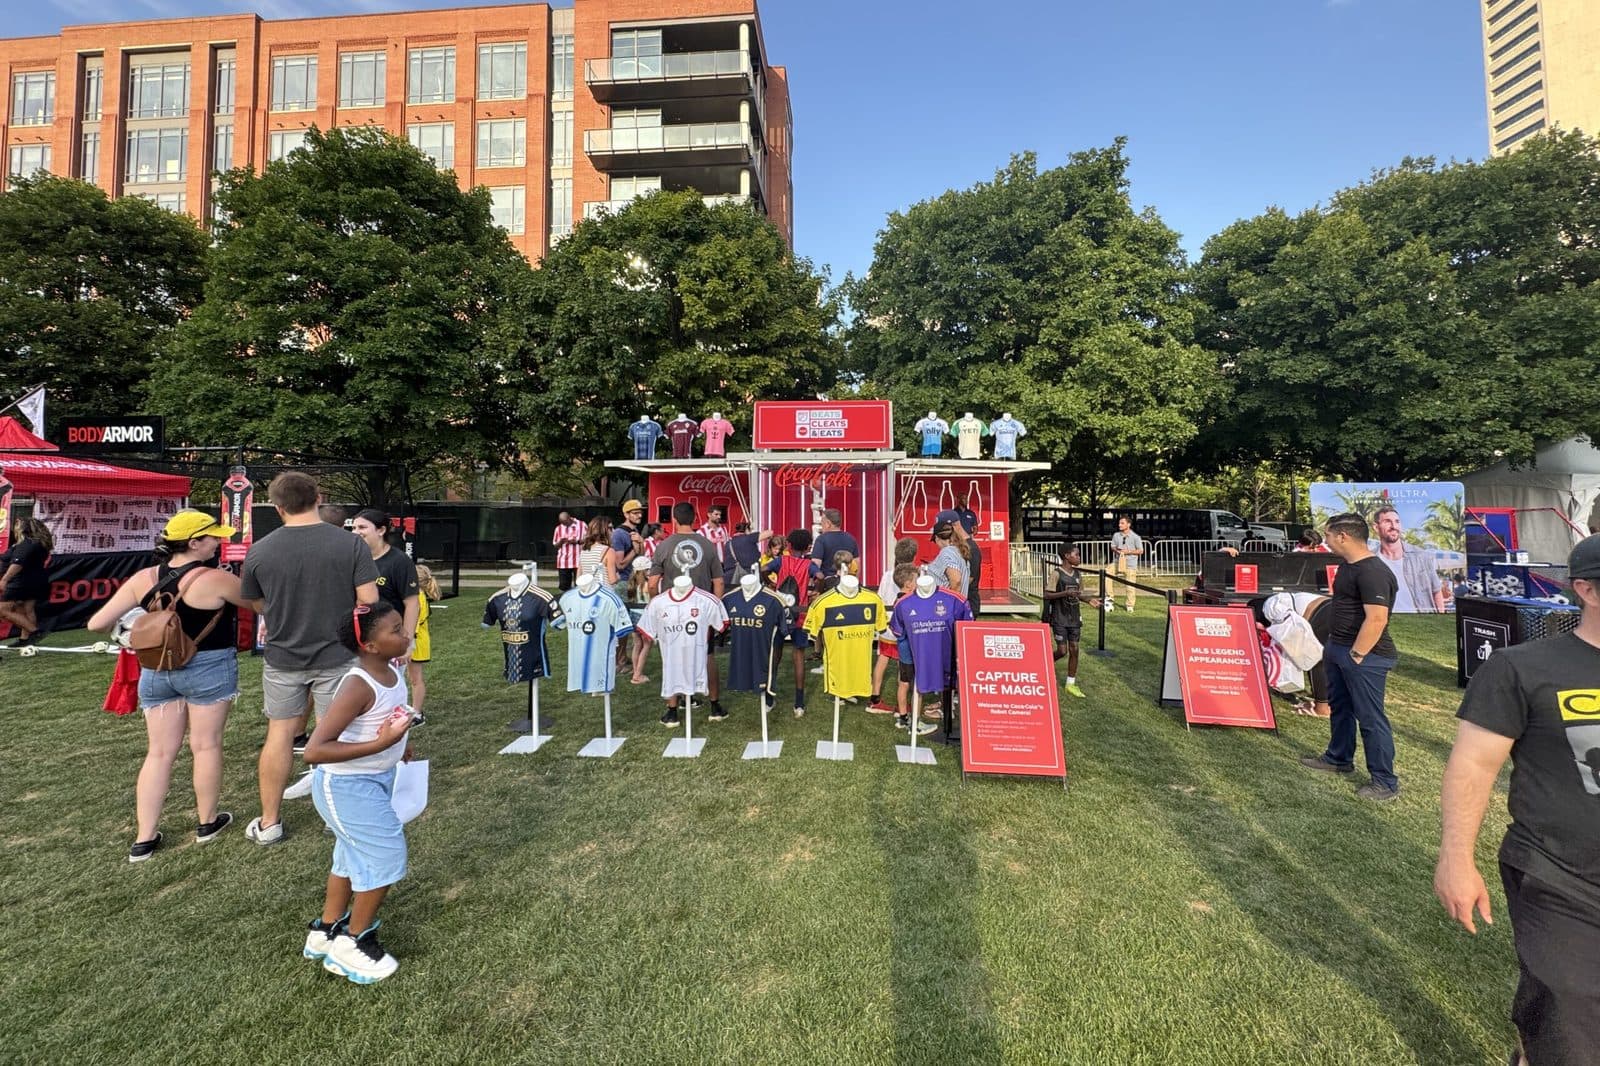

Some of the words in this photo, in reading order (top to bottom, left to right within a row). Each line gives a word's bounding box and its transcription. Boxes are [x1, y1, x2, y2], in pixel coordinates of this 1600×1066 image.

[811, 420, 847, 428] CLEATS
[68, 425, 154, 443] BODYARMOR
[926, 427, 941, 436] ally
[1391, 489, 1428, 498] ULTRA
[1473, 627, 1496, 637] TRASH
[1190, 647, 1210, 655] MLS
[1210, 648, 1246, 656] LEGEND
[1189, 656, 1251, 665] APPEARANCES
[975, 670, 1039, 683] CAPTURE
[971, 683, 998, 695] THE
[1001, 684, 1046, 696] MAGIC
